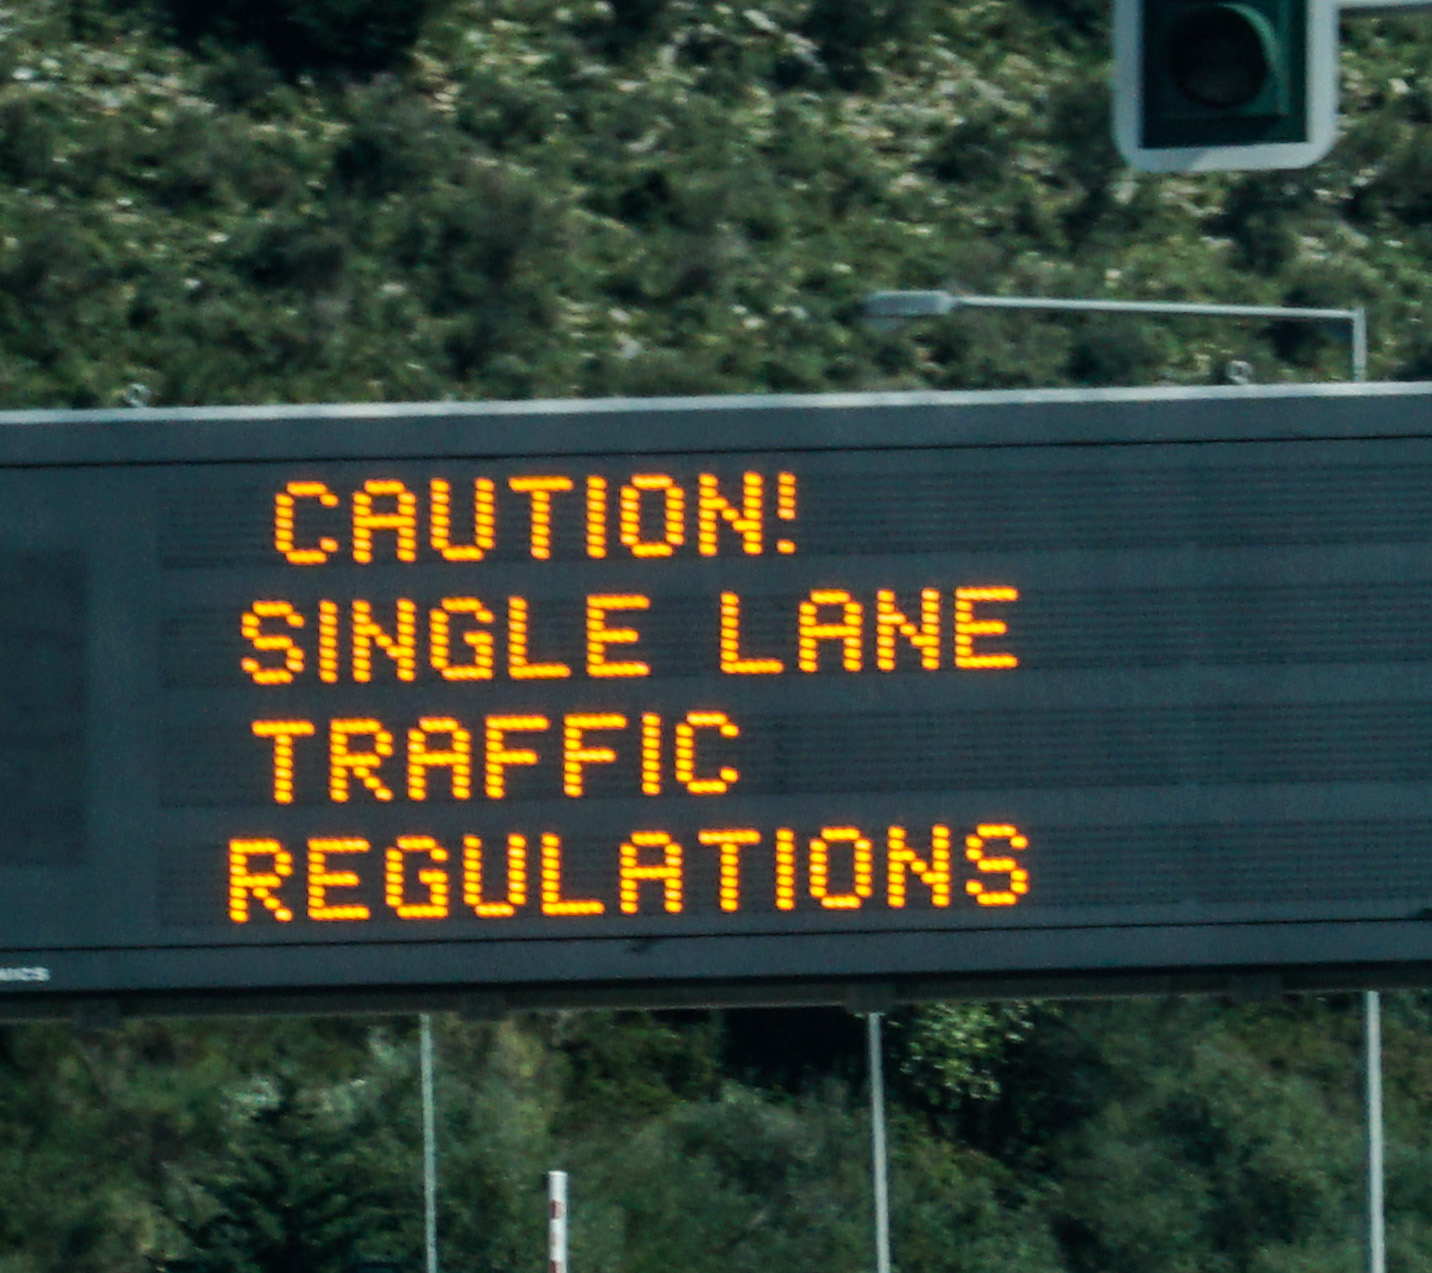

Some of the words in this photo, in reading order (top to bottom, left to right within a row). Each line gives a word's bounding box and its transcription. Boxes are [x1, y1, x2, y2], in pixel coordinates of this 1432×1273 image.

[274, 469, 797, 567] CAUTION!
[239, 592, 652, 687] SINGLE
[718, 584, 1020, 676] LANE
[250, 709, 741, 806] TRAFFIC
[227, 821, 1031, 925] REGULATIONS
